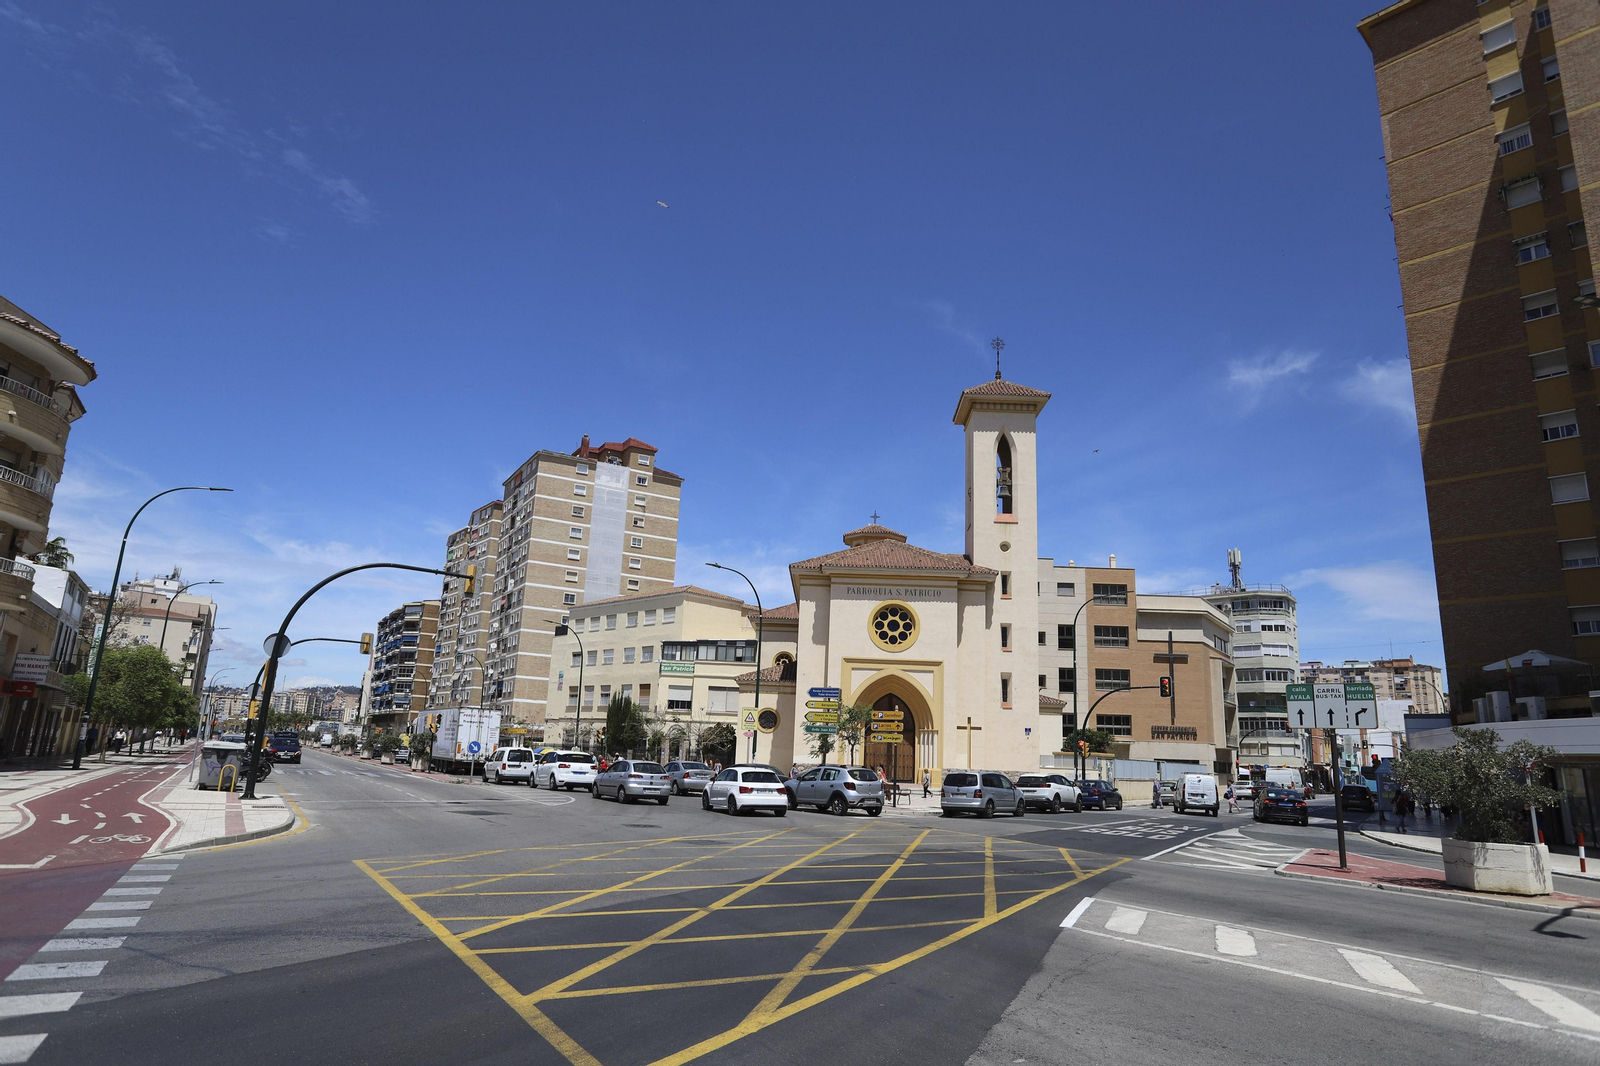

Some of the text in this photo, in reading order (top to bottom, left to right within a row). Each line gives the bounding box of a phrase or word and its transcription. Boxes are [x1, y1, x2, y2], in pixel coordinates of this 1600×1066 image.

[846, 587, 893, 596] PARROQUIA
[904, 588, 942, 597] PATRICIO
[1151, 731, 1197, 741] SAN PATRICIO
